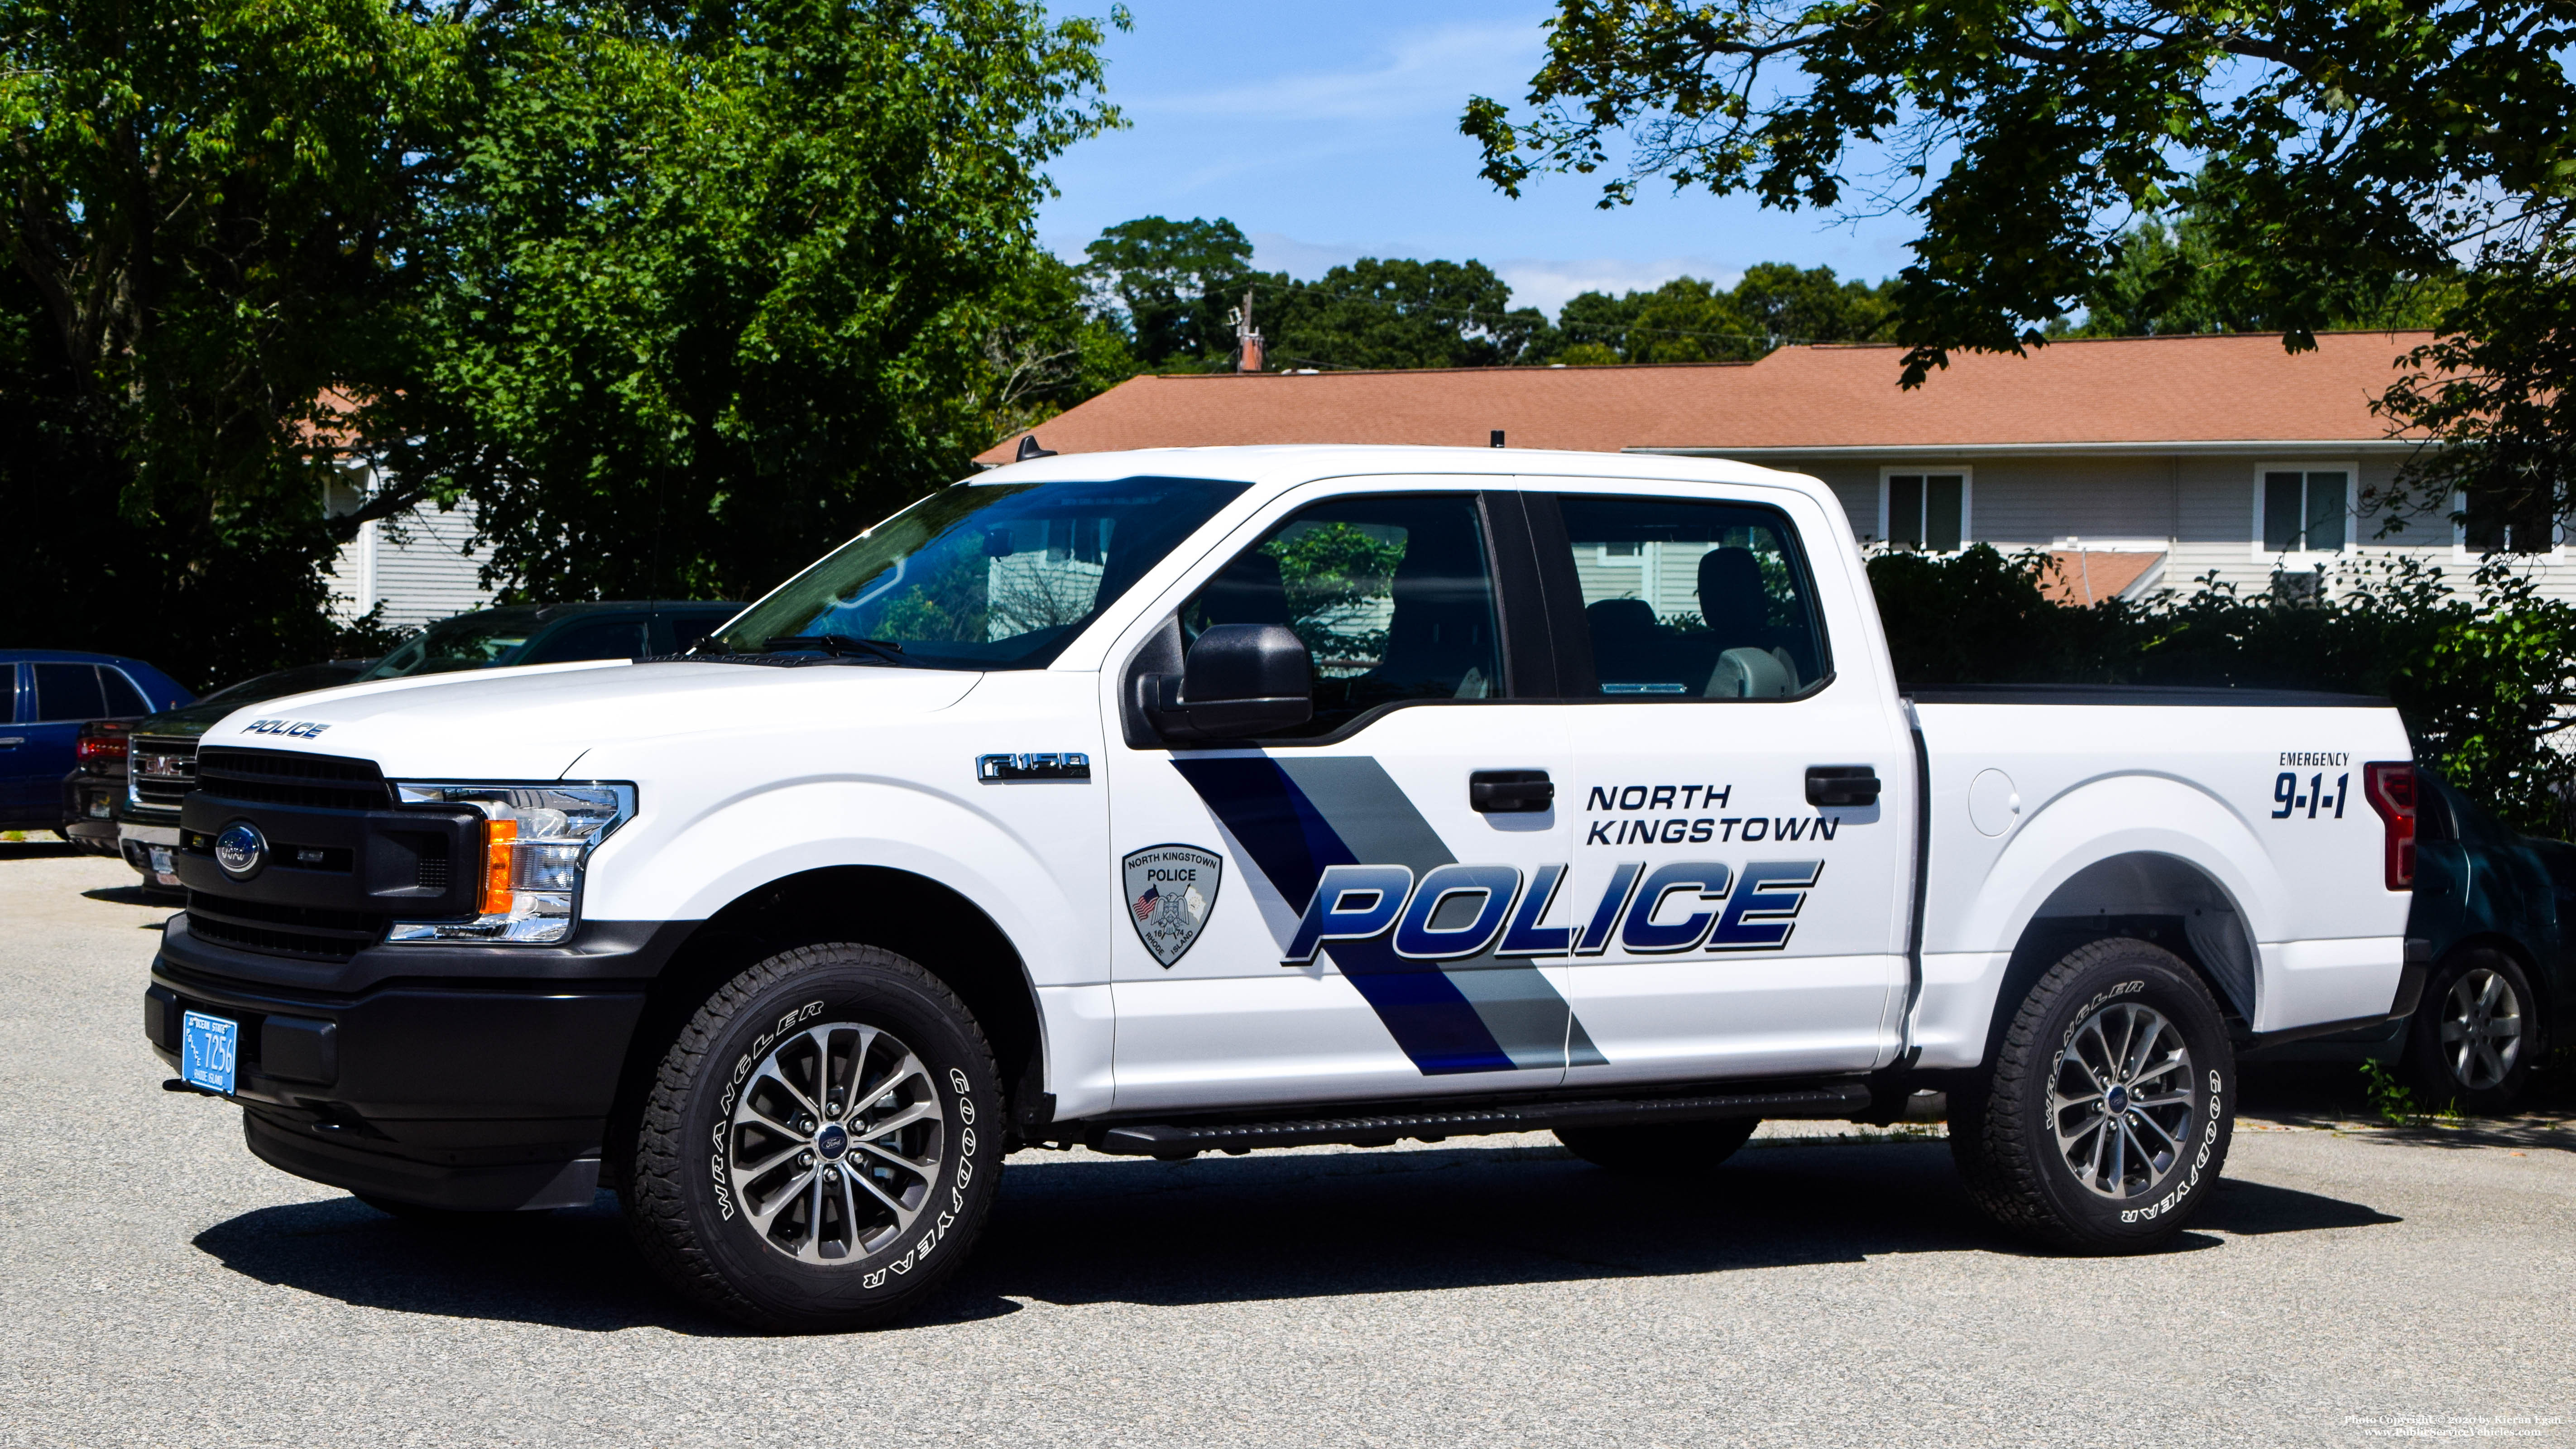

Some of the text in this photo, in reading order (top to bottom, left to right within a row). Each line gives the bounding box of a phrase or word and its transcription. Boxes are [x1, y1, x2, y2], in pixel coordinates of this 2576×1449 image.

[240, 720, 332, 739] POLICE
[2280, 752, 2349, 766] EMERGENCY
[1586, 785, 1732, 811] NORTH
[2271, 772, 2349, 819] 9-1-1
[1586, 816, 1840, 845] KINGSTOWN
[1128, 852, 1216, 869] NORTH KINGSTOWN
[1147, 869, 1196, 881] POLICE
[1280, 859, 1825, 967] POLICE
[1146, 930, 1193, 956] RHODE ISLAND
[196, 1019, 225, 1034] OCEAN STATE
[187, 1028, 201, 1066] POLICE
[205, 1033, 232, 1074] 7256
[2045, 981, 2144, 1130] WRANGLER
[194, 1069, 223, 1086] RHODE ISLAND
[712, 1001, 824, 1221] WRANGLER
[826, 1138, 841, 1147] Ford
[2121, 1070, 2221, 1223] GOODYEAR
[863, 1068, 975, 1289] GOODYEAR
